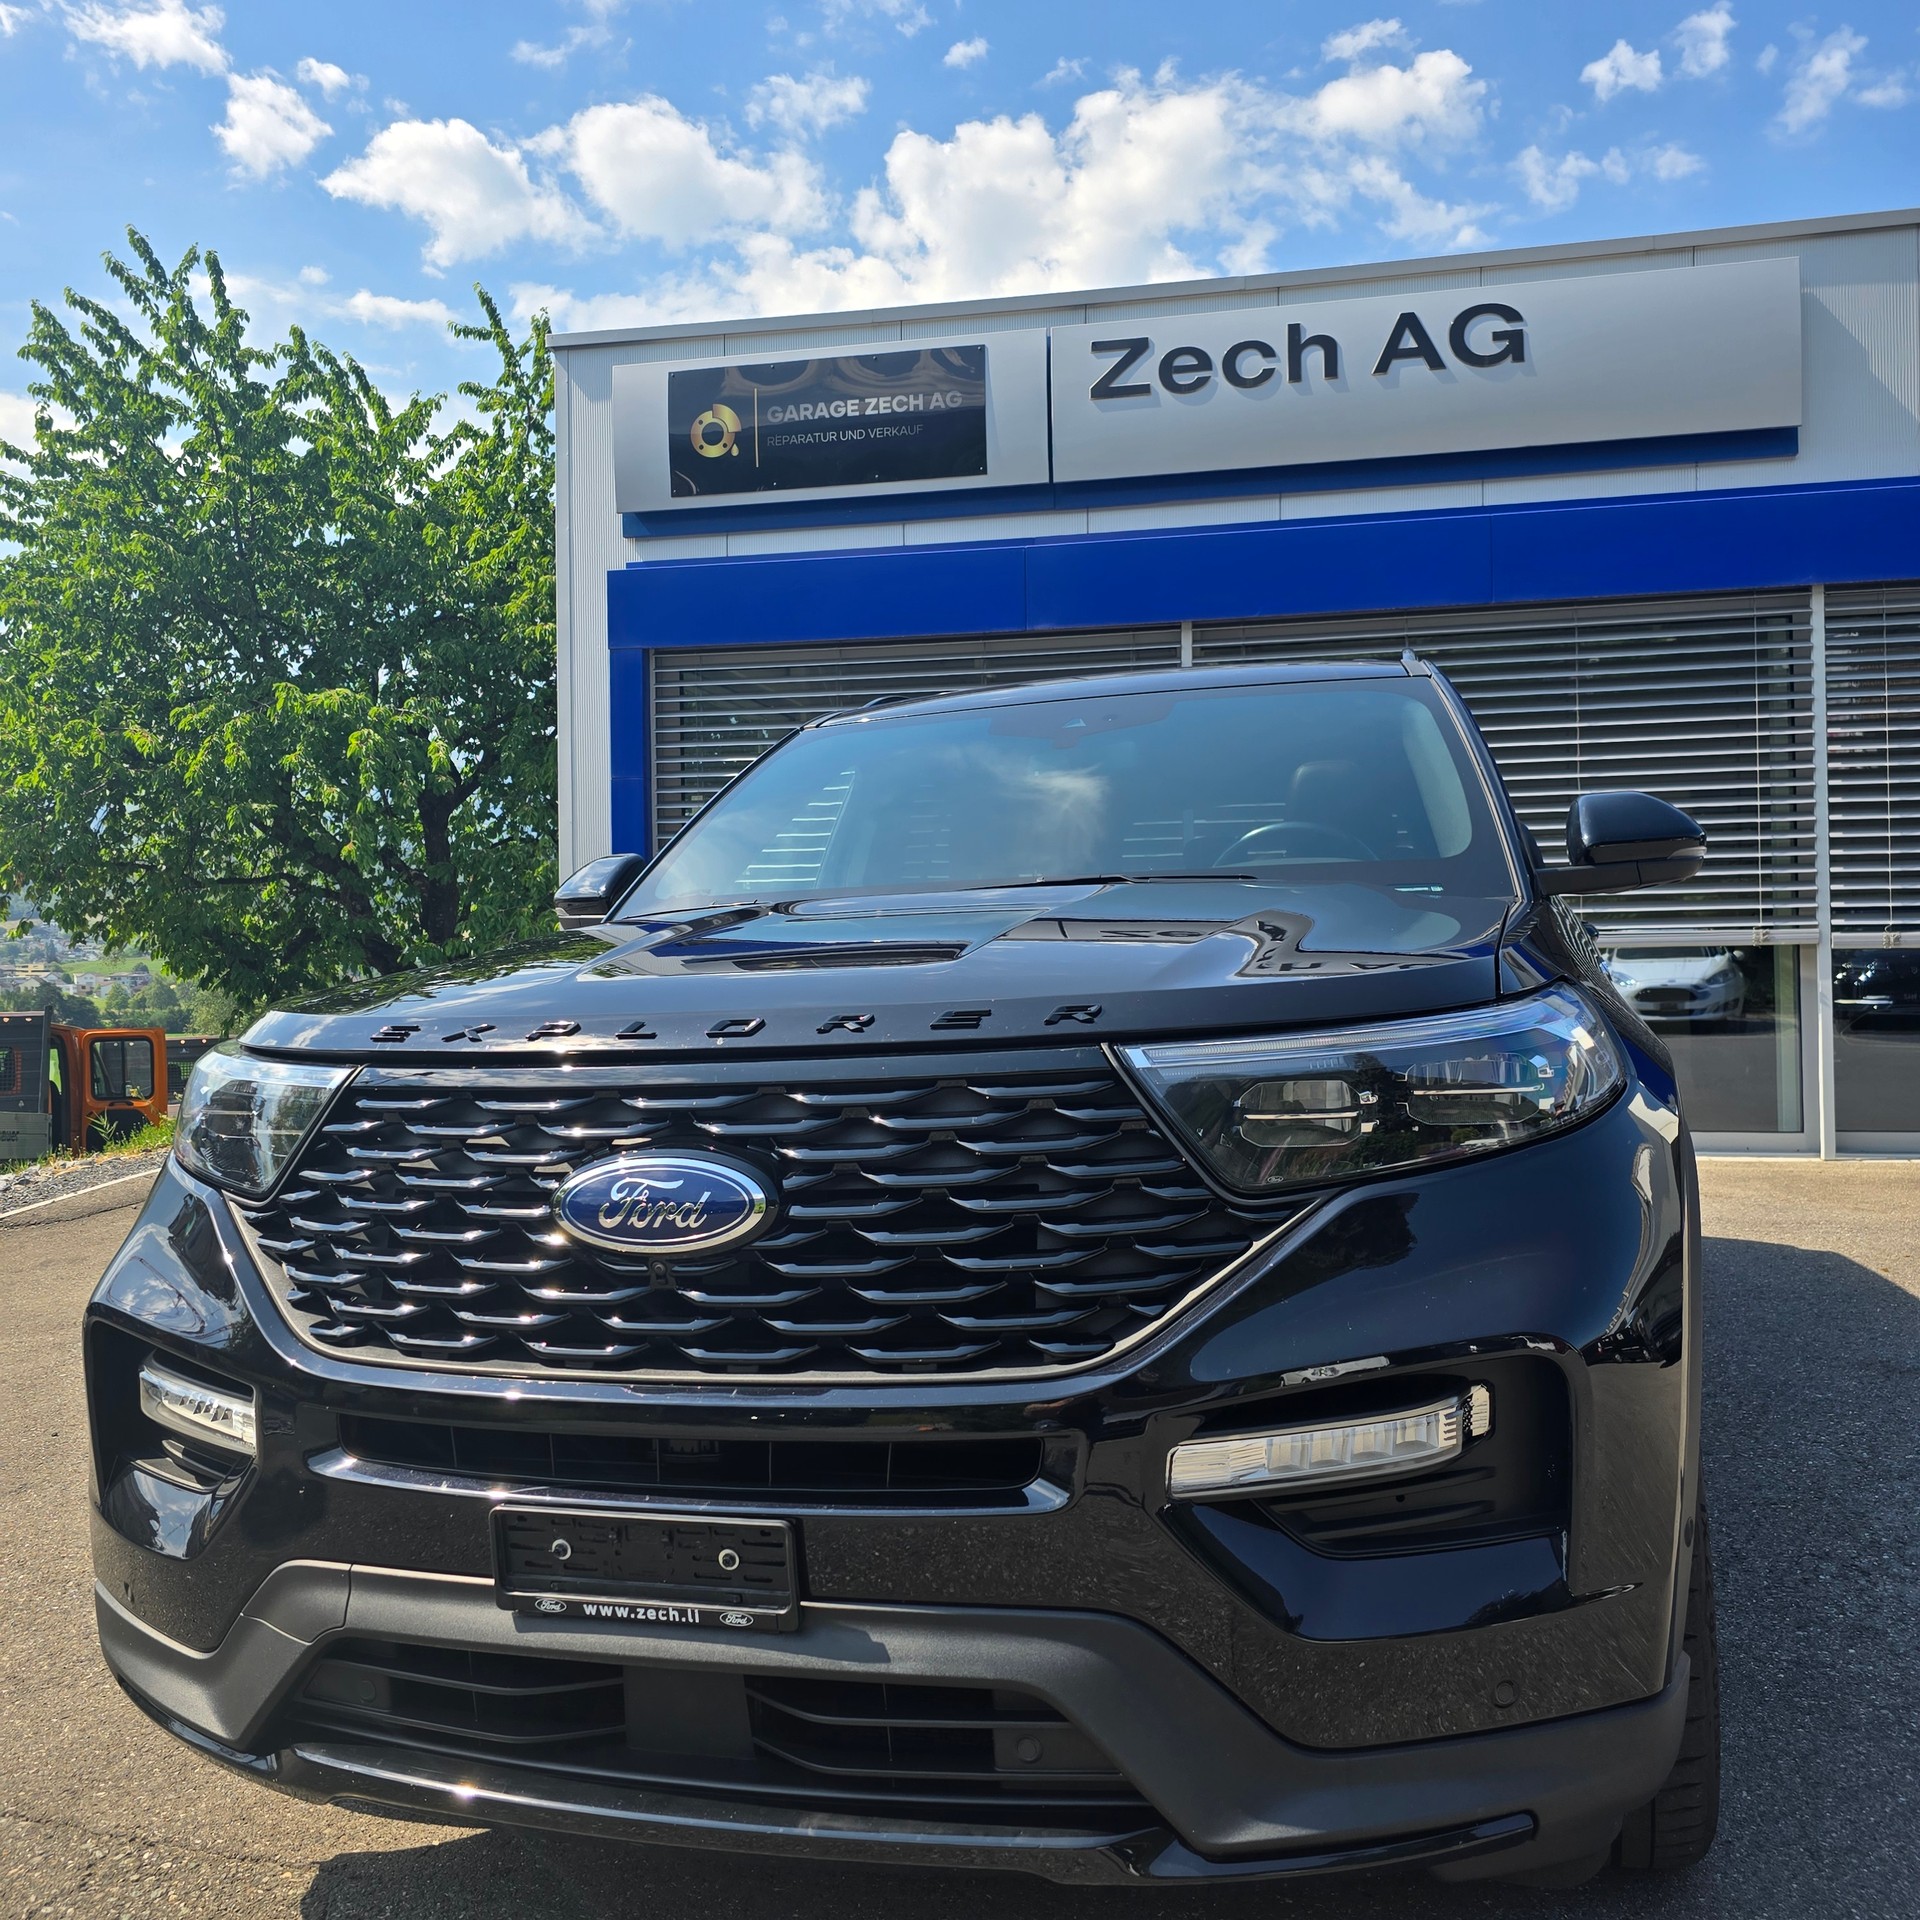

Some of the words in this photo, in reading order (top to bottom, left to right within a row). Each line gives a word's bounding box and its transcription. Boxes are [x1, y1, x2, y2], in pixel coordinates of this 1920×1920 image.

[1089, 322, 1338, 400] Zech
[1371, 302, 1525, 376] AG
[767, 399, 860, 422] GARAGE
[864, 394, 923, 415] ZECH
[929, 390, 963, 411] AG
[767, 431, 837, 446] REPARATUR
[839, 429, 866, 441] UND
[868, 424, 924, 438] VERKAUF
[369, 1002, 1105, 1044] EXPLORER
[598, 1176, 712, 1229] Ford
[540, 1600, 561, 1611] Ford
[583, 1603, 700, 1623] www.zech.li
[725, 1613, 748, 1624] Ford
